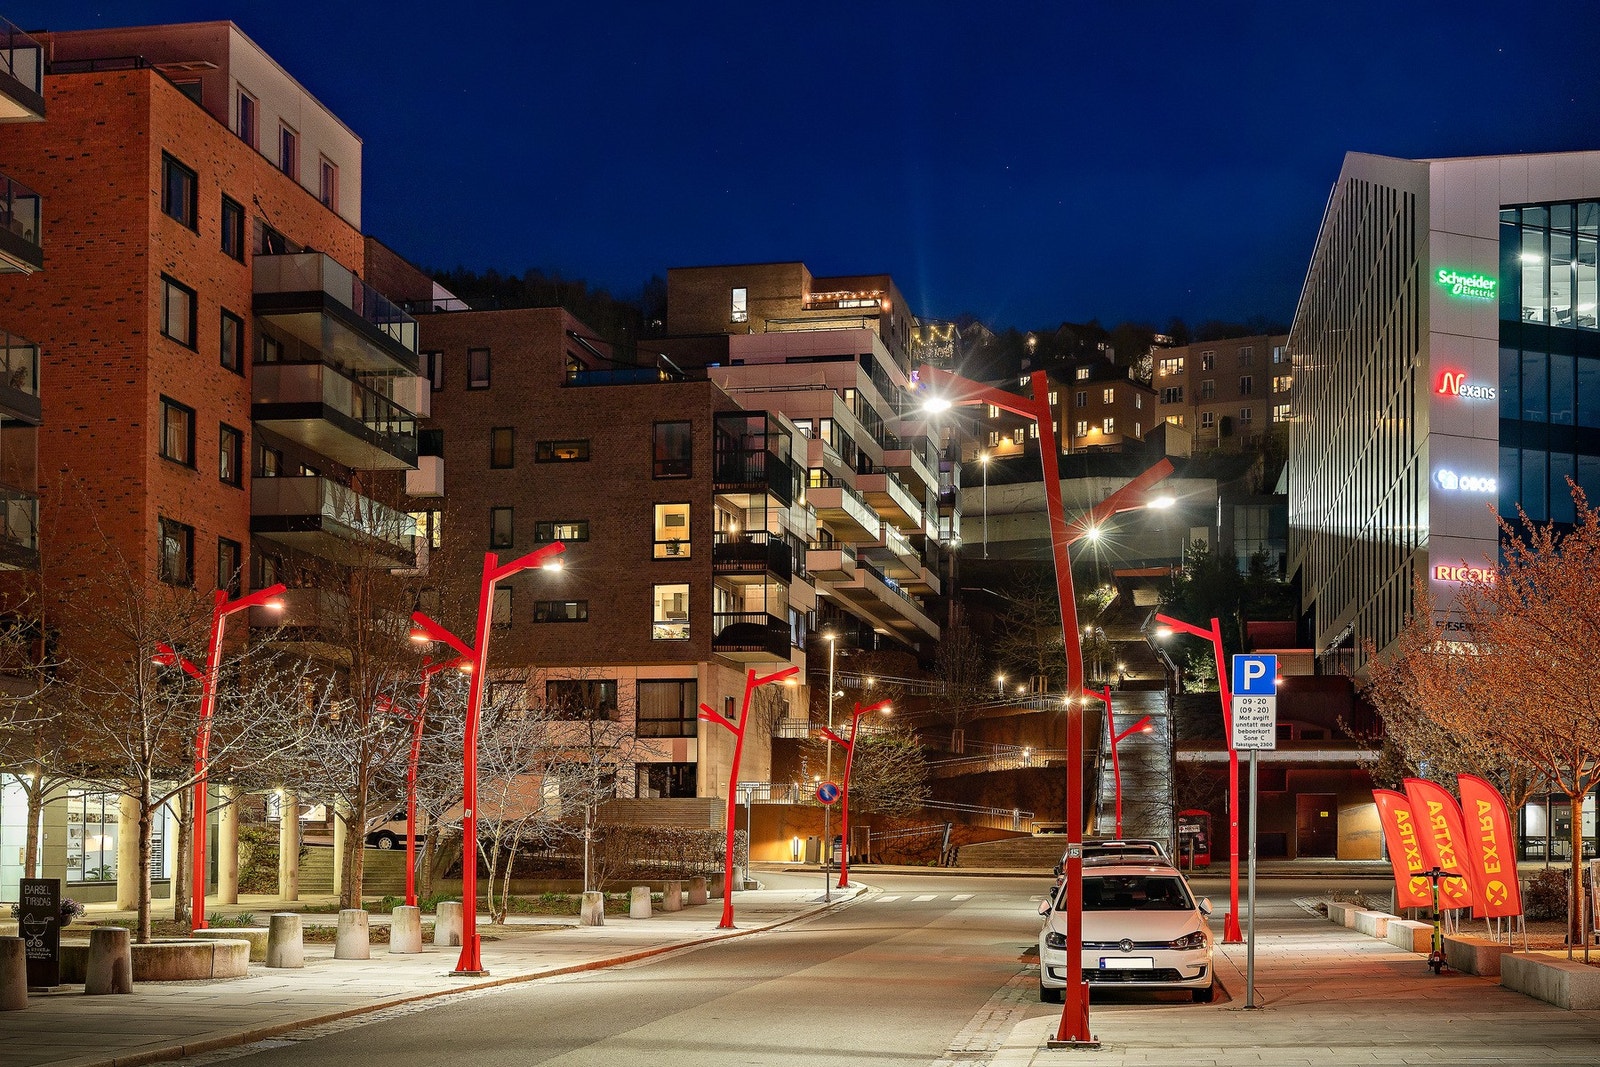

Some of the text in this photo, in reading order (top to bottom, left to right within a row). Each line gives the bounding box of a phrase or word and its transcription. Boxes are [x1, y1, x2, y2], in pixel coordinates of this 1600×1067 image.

[1438, 269, 1497, 290] Schneider
[1462, 285, 1495, 298] Electric
[1438, 372, 1496, 399] Nexans
[1243, 660, 1266, 690] P
[24, 885, 51, 895] BARSEL
[25, 896, 51, 906] TIRSDAG
